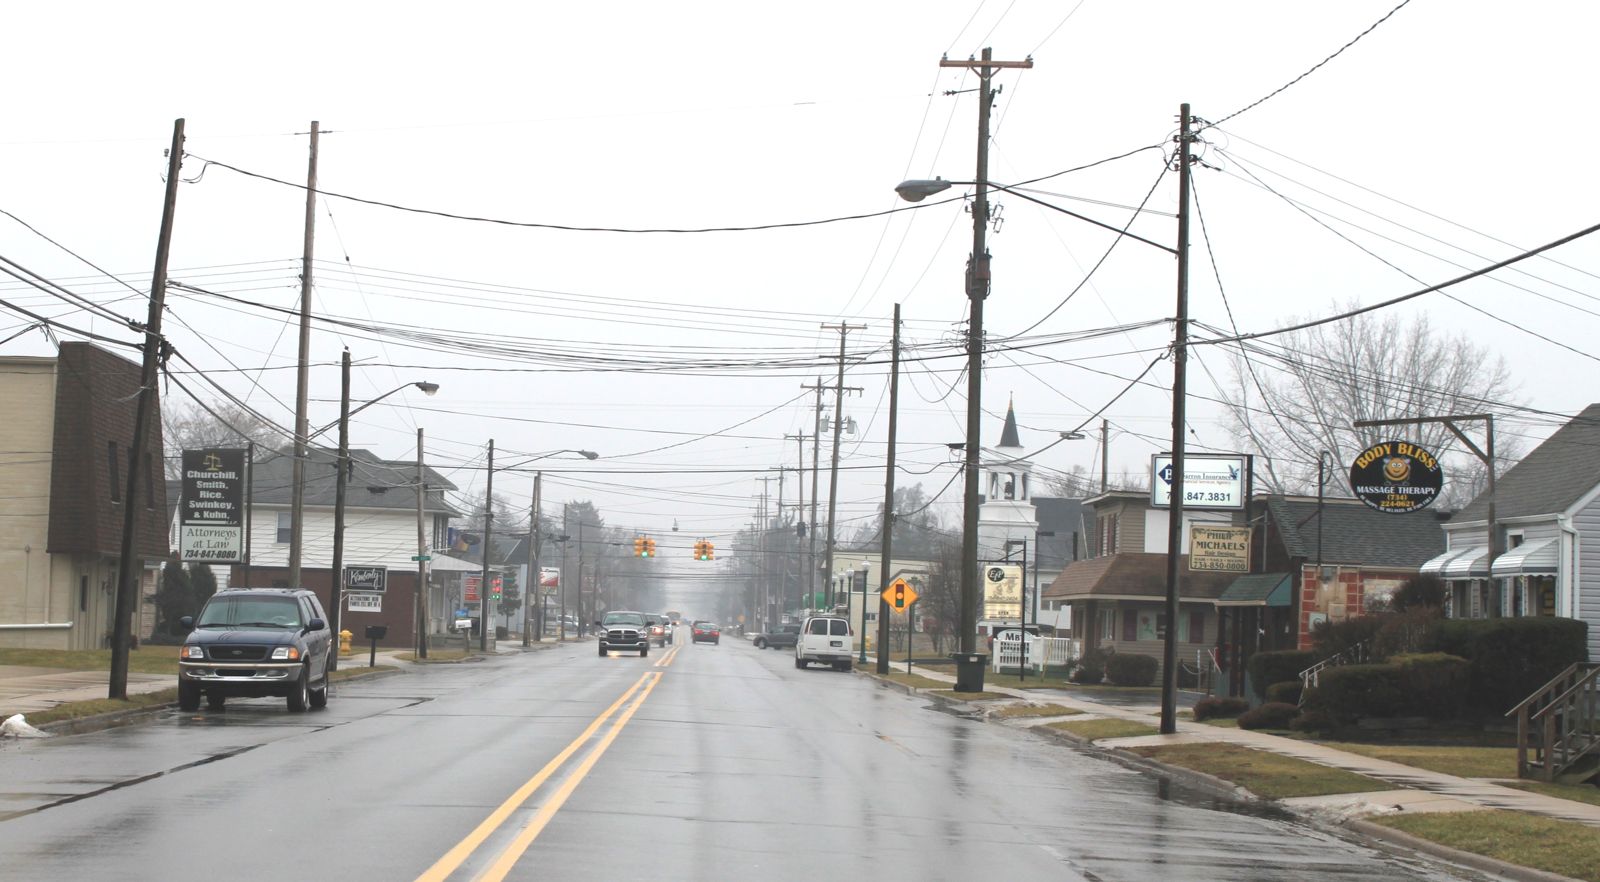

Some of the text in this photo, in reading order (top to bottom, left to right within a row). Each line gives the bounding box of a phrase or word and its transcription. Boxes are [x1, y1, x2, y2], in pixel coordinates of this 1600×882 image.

[1356, 443, 1437, 469] BODY BLISS
[187, 470, 239, 480] Churchill,
[196, 480, 229, 490] Smith,
[1356, 486, 1436, 495] MASSAGE THERAPY
[1166, 491, 1231, 502] 7.847.3831
[194, 511, 201, 519] &
[187, 528, 237, 540] Attorneys
[193, 540, 230, 549] at Law
[1196, 541, 1245, 550] MICHAELS
